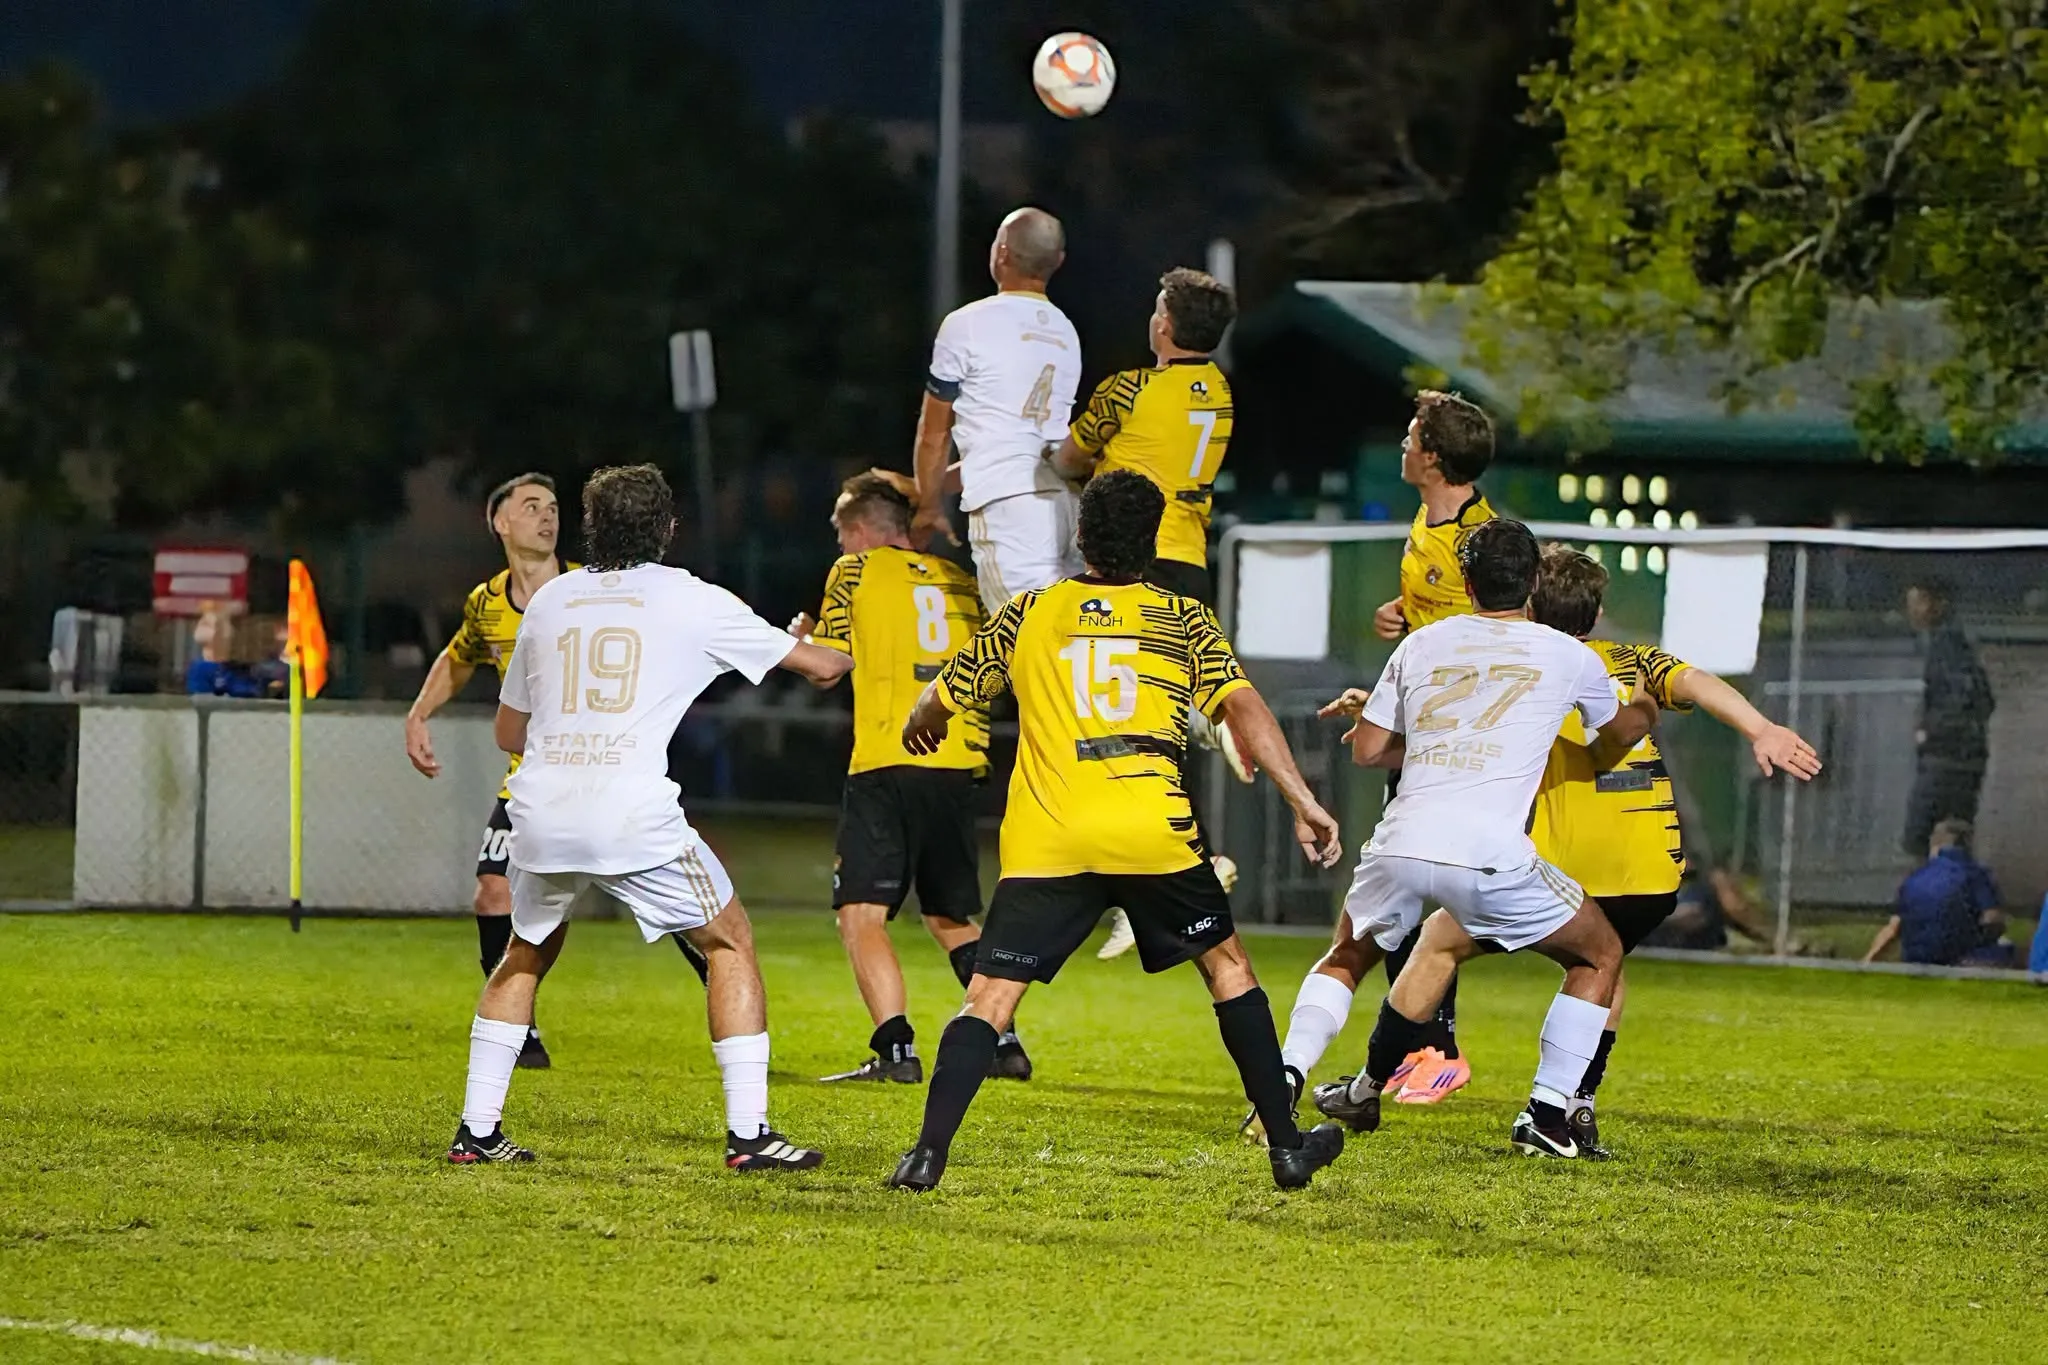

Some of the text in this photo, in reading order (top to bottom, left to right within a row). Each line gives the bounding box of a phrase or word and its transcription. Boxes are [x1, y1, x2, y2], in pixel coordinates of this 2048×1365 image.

[1021, 363, 1056, 432] 4
[1188, 411, 1217, 478] 7
[913, 585, 950, 653] 8
[1079, 615, 1123, 627] FNQH
[557, 627, 643, 714] 19
[1060, 639, 1139, 722] 15
[1416, 664, 1542, 731] 27
[544, 750, 621, 766] SIGNS
[478, 827, 510, 861] 20
[995, 951, 1014, 960] ANDY
[1021, 956, 1033, 964] CO
[1187, 916, 1212, 935] LSC
